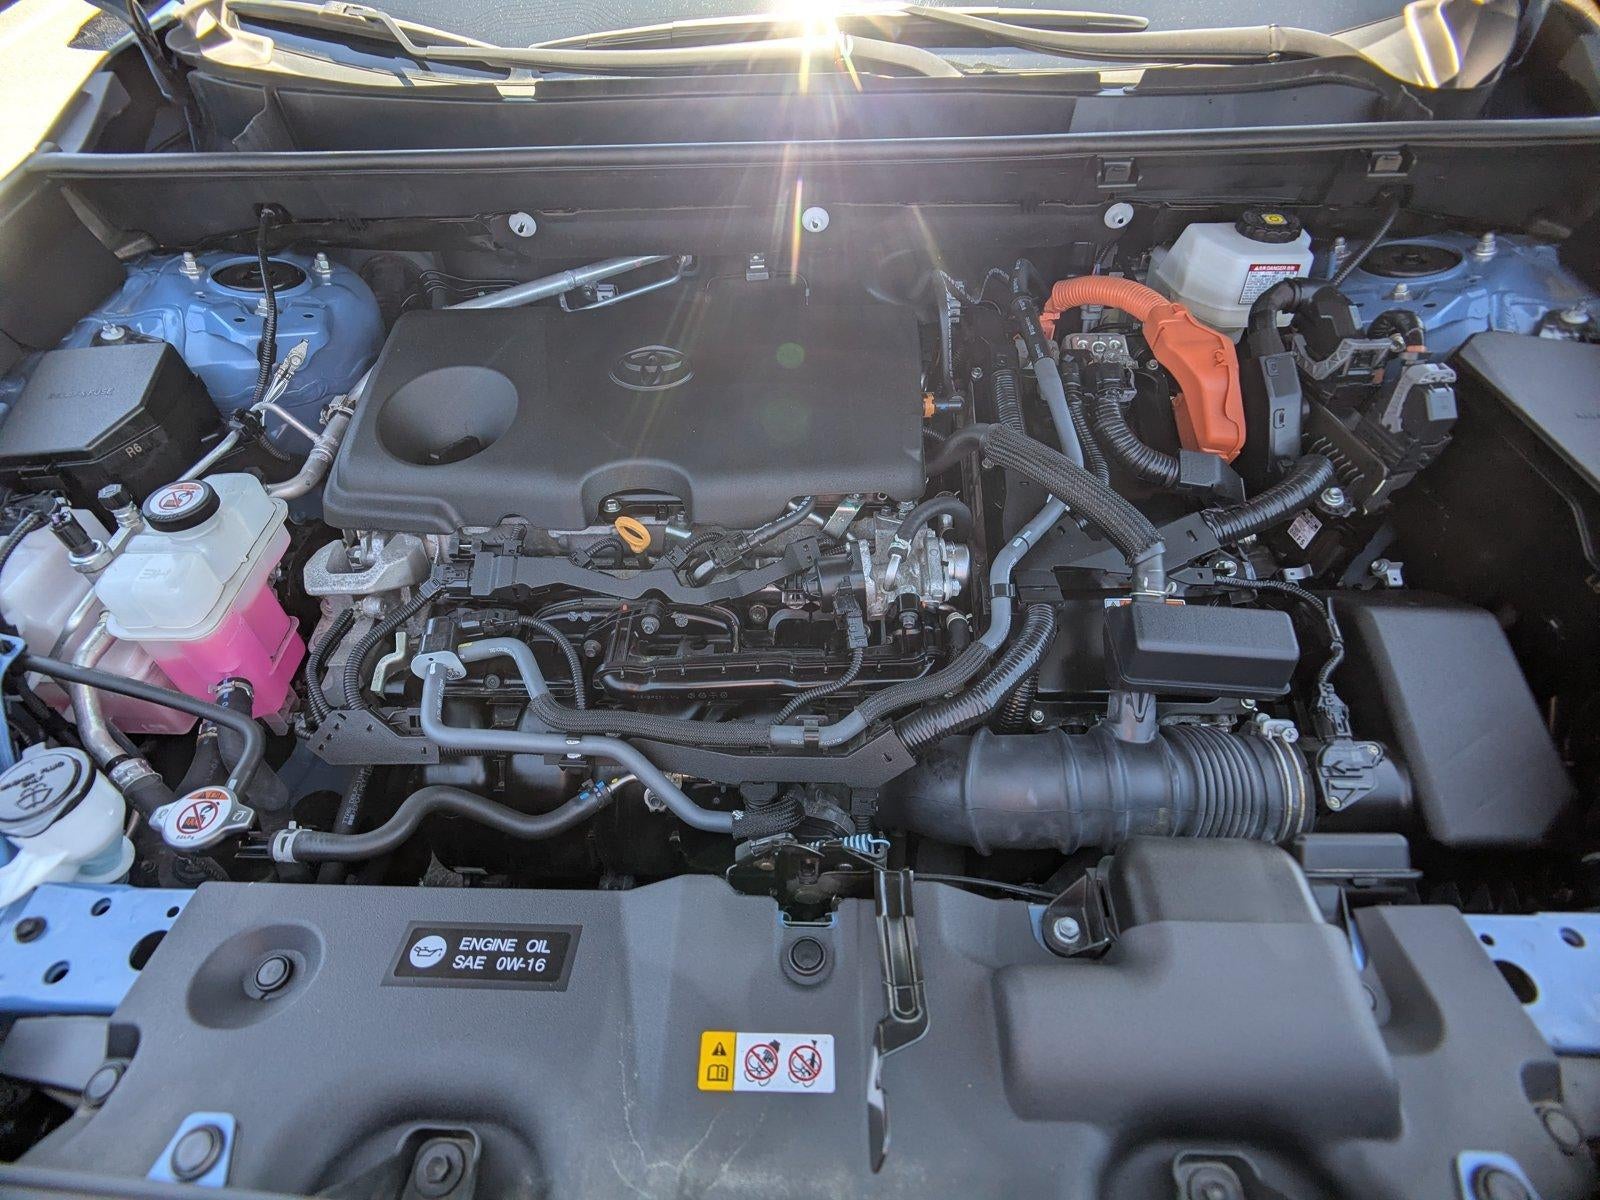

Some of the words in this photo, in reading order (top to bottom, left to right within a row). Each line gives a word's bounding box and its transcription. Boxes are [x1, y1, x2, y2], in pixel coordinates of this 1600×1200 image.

[124, 443, 143, 459] R6
[459, 937, 518, 952] ENGINE
[526, 939, 551, 954] OIL
[452, 955, 487, 970] SAE
[496, 957, 546, 972] 0W-16
